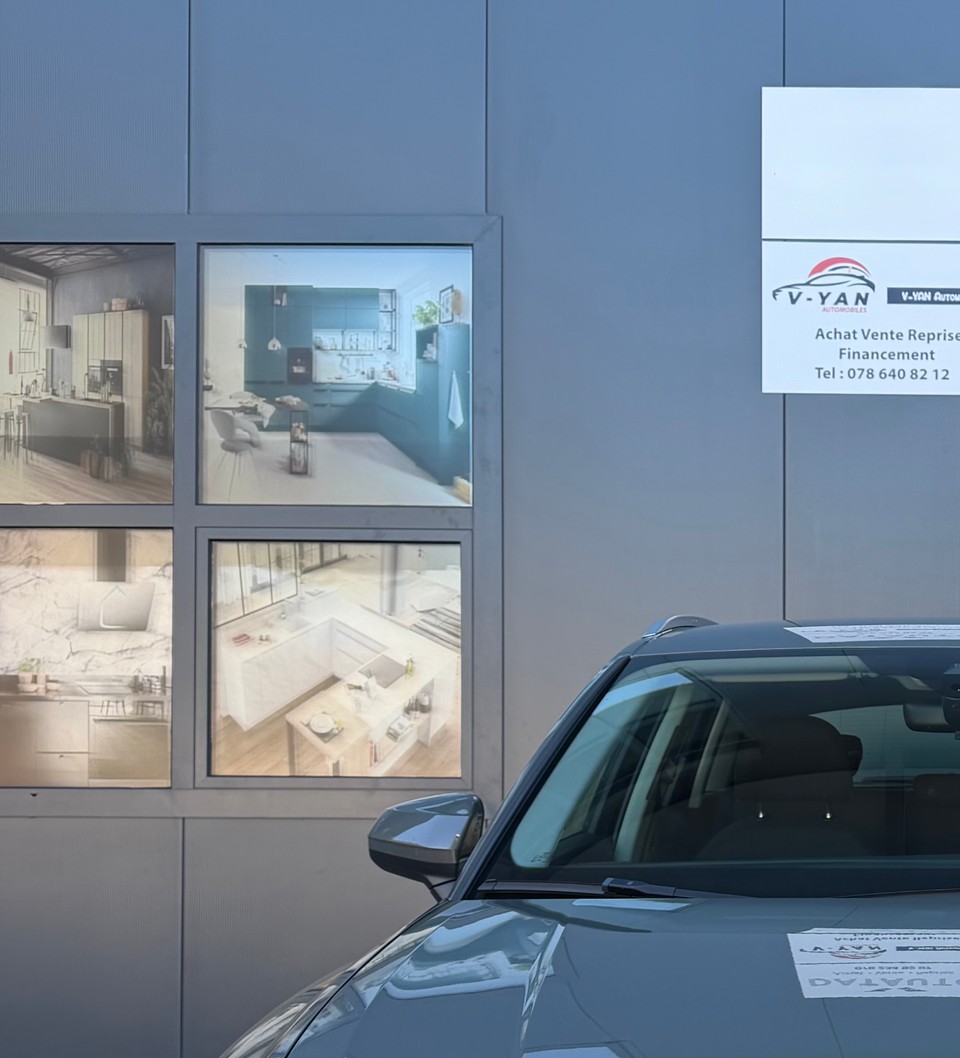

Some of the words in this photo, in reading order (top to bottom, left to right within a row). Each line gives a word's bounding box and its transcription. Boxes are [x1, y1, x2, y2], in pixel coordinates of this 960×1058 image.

[788, 291, 869, 306] V-YAN
[901, 291, 932, 302] V-YAN
[815, 328, 858, 341] Achat
[861, 328, 904, 341] Vente
[839, 348, 936, 361] Financement
[847, 367, 875, 380] 078
[878, 368, 906, 380] 640
[910, 368, 928, 380] 82
[933, 368, 950, 381] 12
